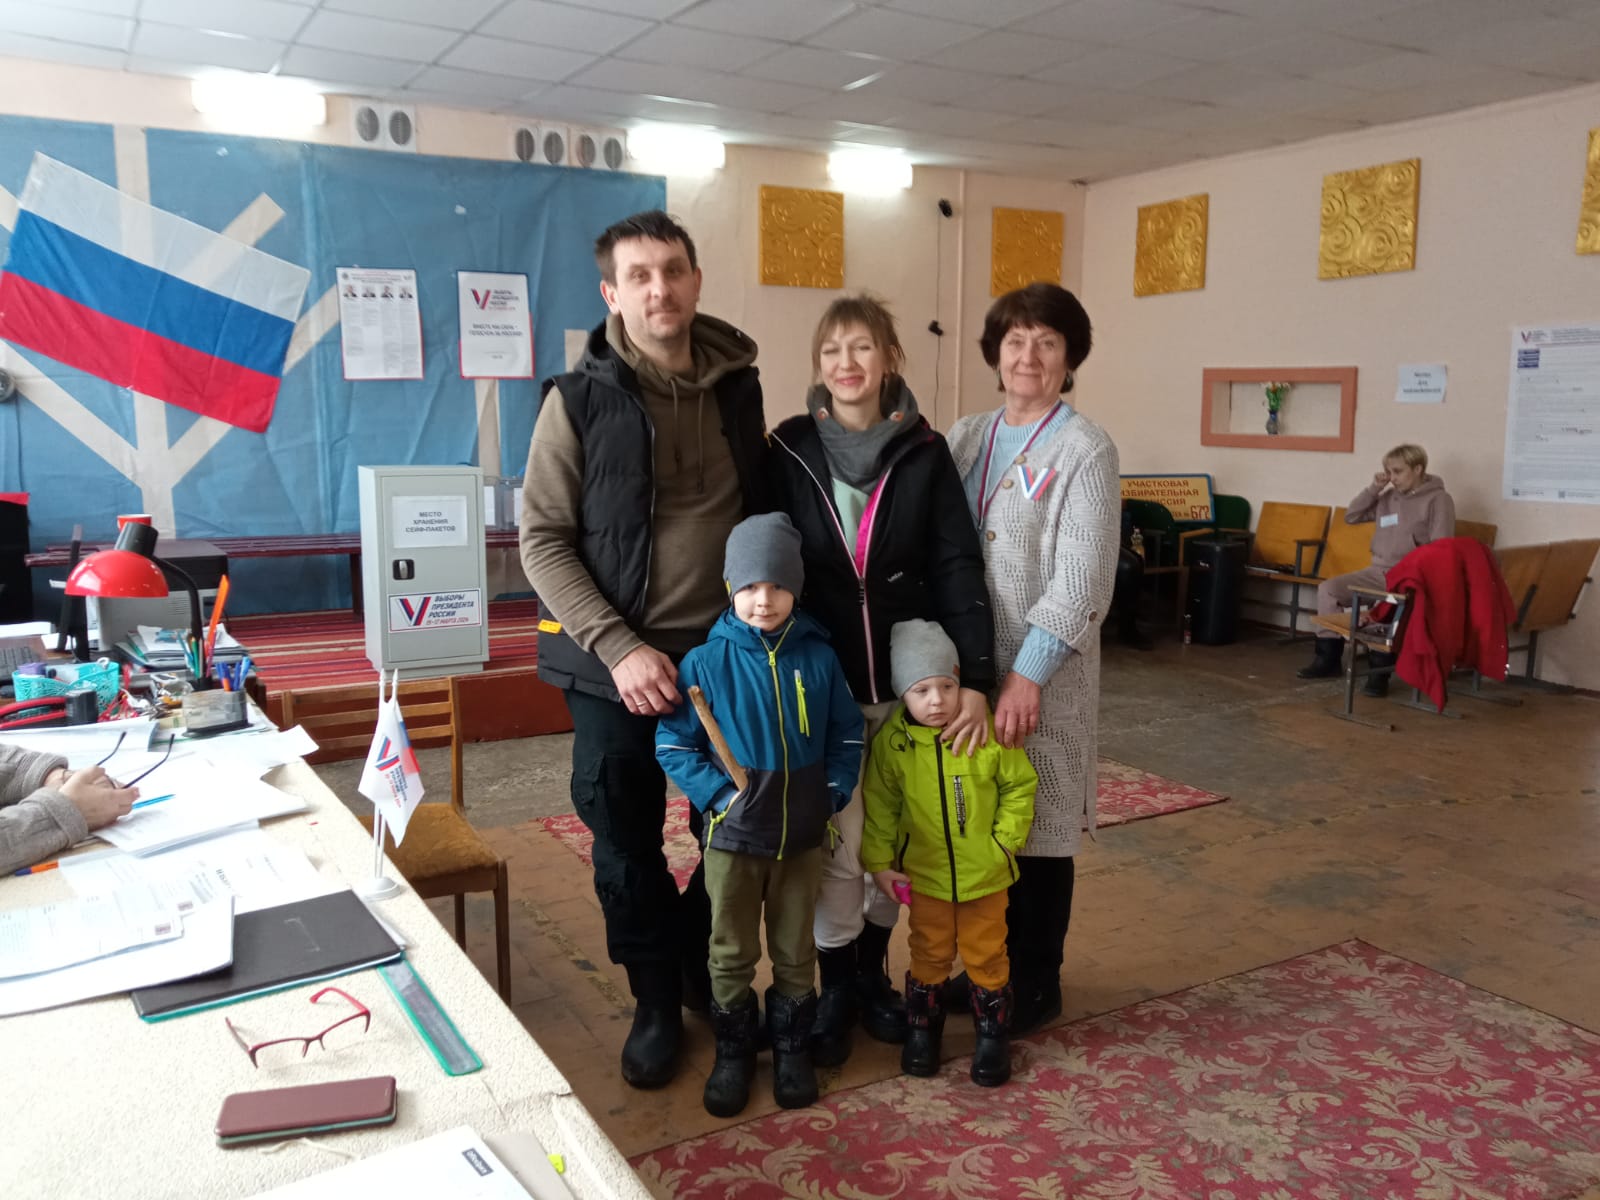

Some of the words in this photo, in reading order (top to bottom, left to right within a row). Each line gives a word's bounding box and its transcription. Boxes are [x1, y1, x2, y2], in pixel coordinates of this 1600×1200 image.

[1127, 480, 1189, 488] УЧАСТКОВАЯ
[405, 525, 456, 533] СЕЙФ-ПАКЕТОВ
[435, 594, 465, 602] ВЫБОРЫ
[431, 601, 474, 610] ПРЕЗИДЕНТА
[428, 610, 457, 618] РОССИИ
